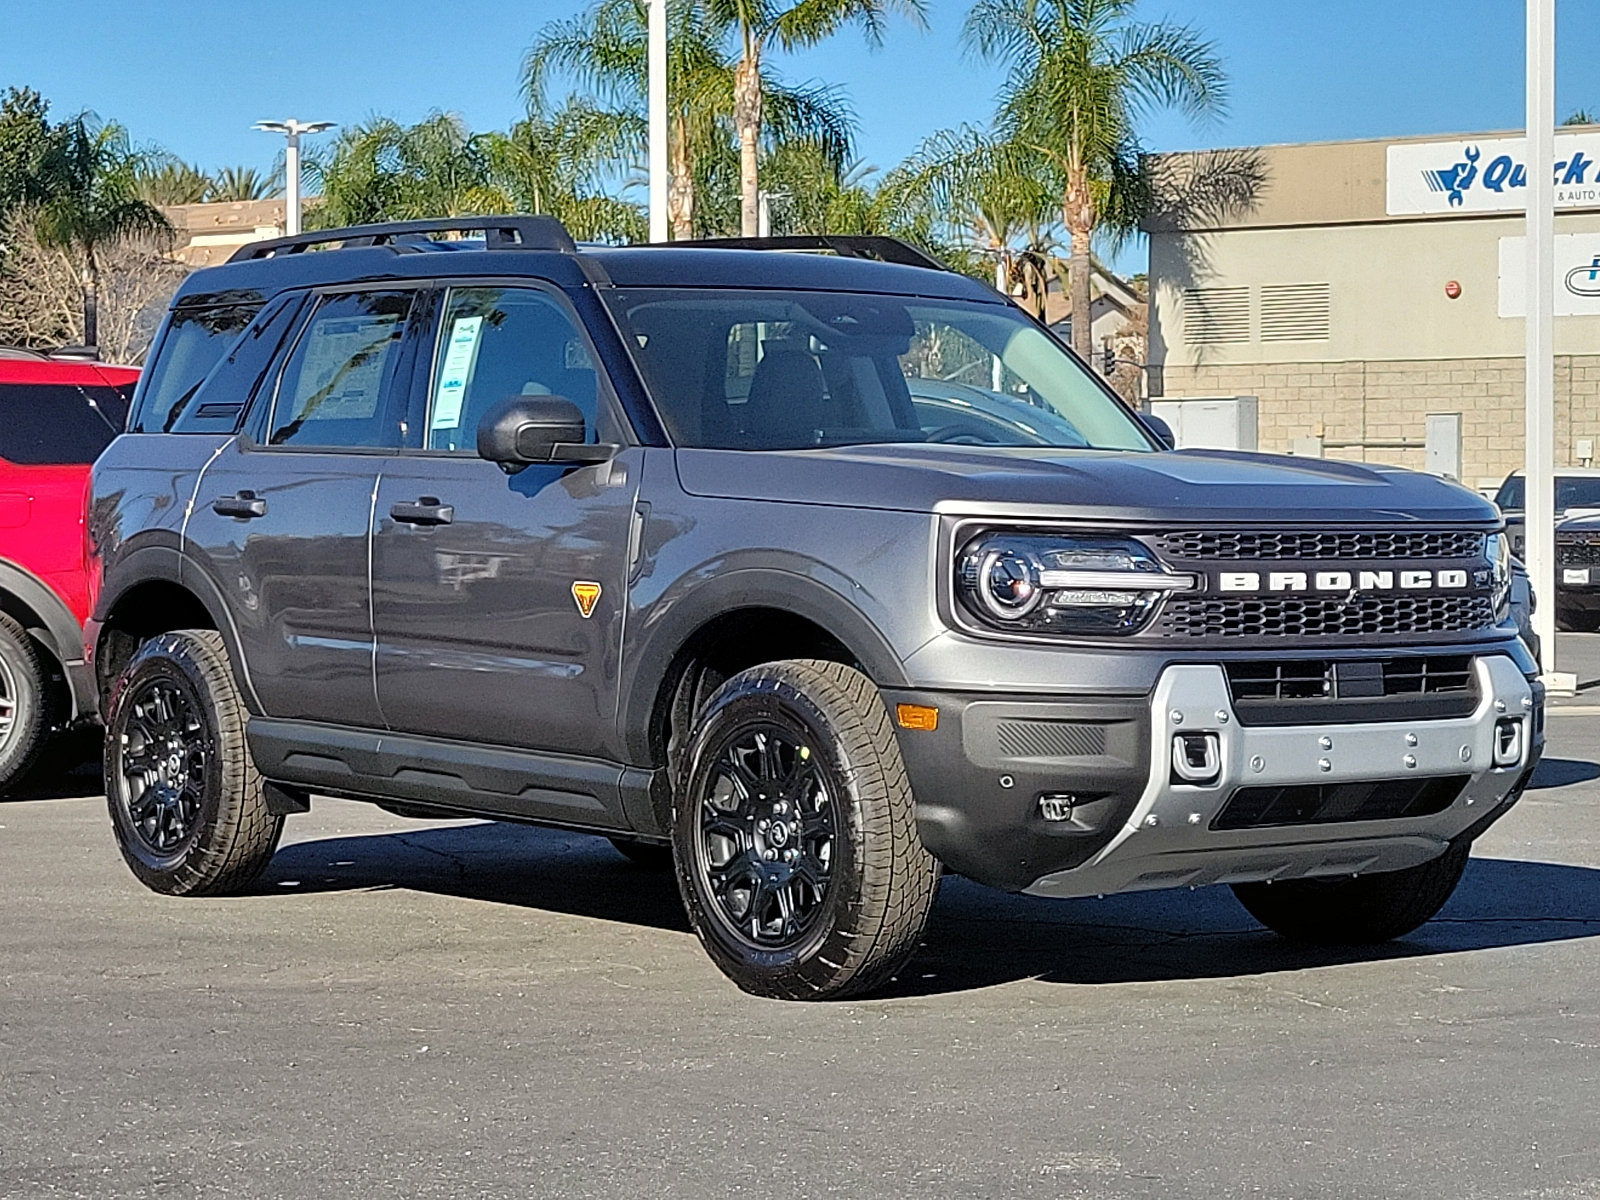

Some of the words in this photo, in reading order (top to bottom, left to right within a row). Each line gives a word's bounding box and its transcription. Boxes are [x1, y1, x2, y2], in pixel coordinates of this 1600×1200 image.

[1483, 152, 1593, 192] Quck
[1558, 191, 1565, 201] &
[1568, 190, 1595, 200] AUTO
[1220, 570, 1467, 591] BRONCO
